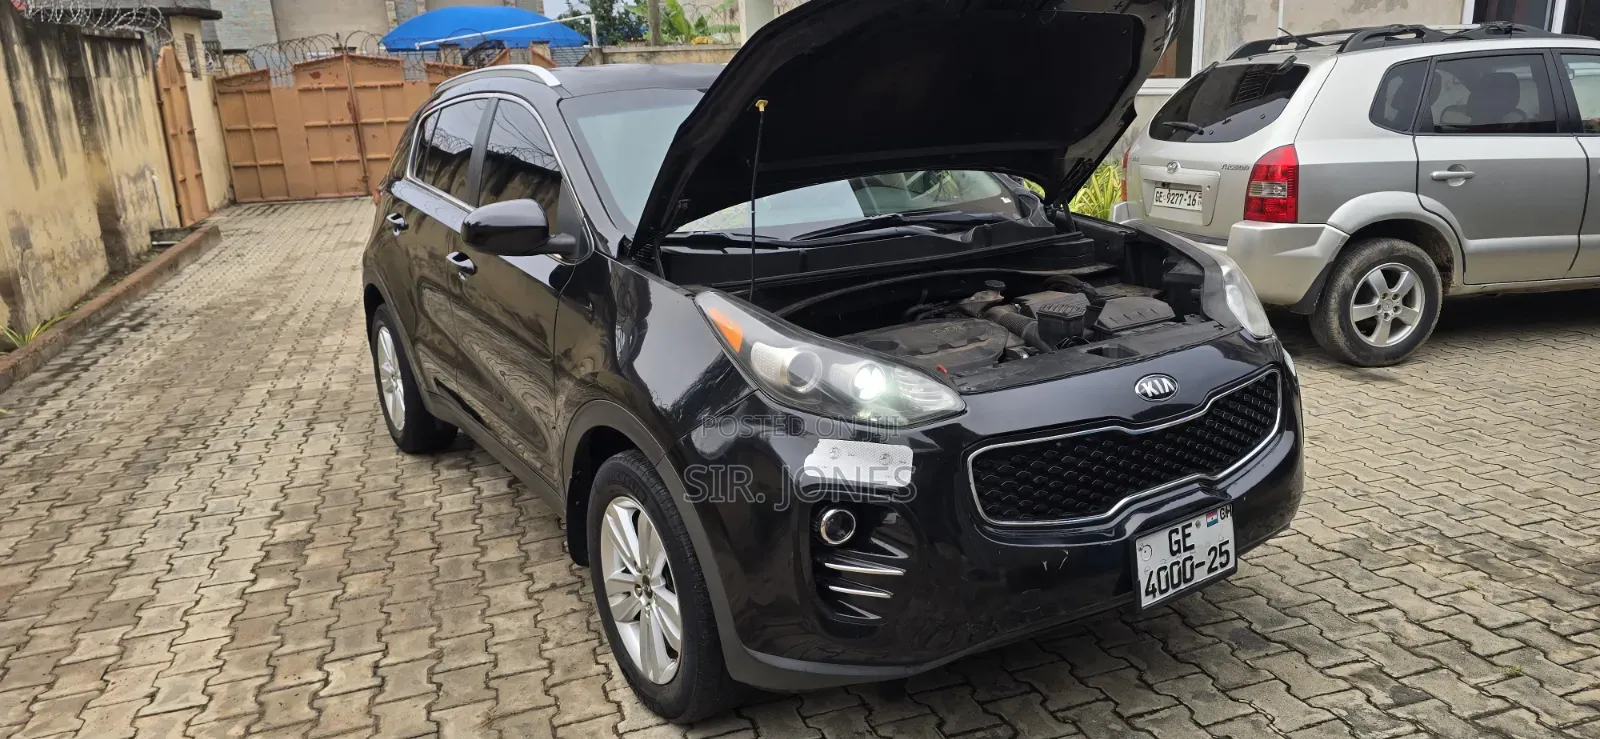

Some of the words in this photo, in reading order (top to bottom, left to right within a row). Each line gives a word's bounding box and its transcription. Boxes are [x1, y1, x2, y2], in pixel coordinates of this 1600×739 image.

[1155, 190, 1163, 203] GE
[1140, 377, 1175, 398] KIA
[1219, 504, 1233, 521] GH
[1168, 521, 1195, 557] GE
[1144, 539, 1231, 599] 4000-25
